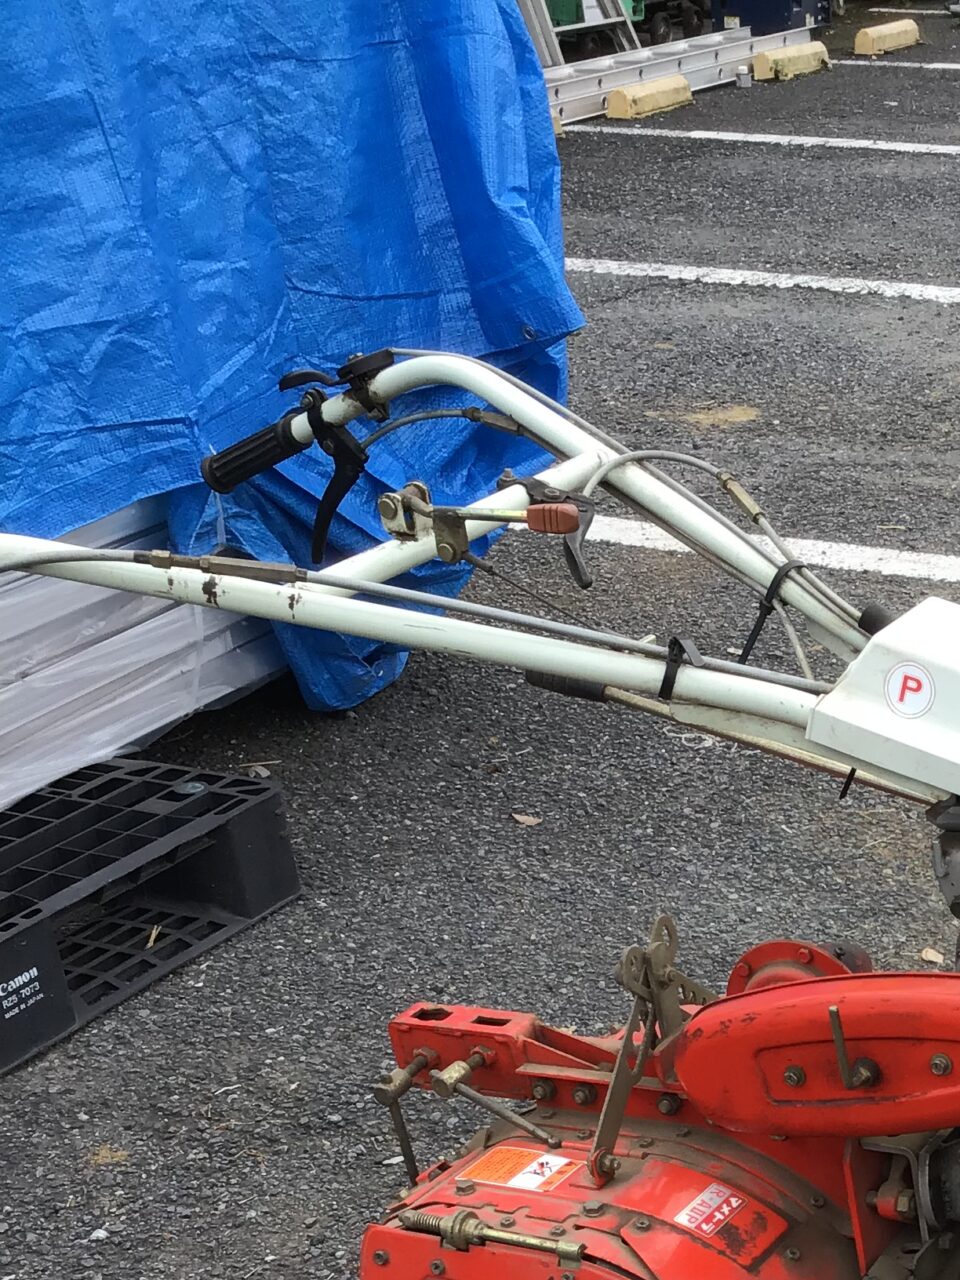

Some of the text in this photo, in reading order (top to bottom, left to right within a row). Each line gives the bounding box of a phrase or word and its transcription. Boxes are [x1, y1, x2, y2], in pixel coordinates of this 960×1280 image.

[898, 674, 923, 703] P
[0, 966, 39, 997] Canon
[700, 1196, 743, 1234] マメトラ
